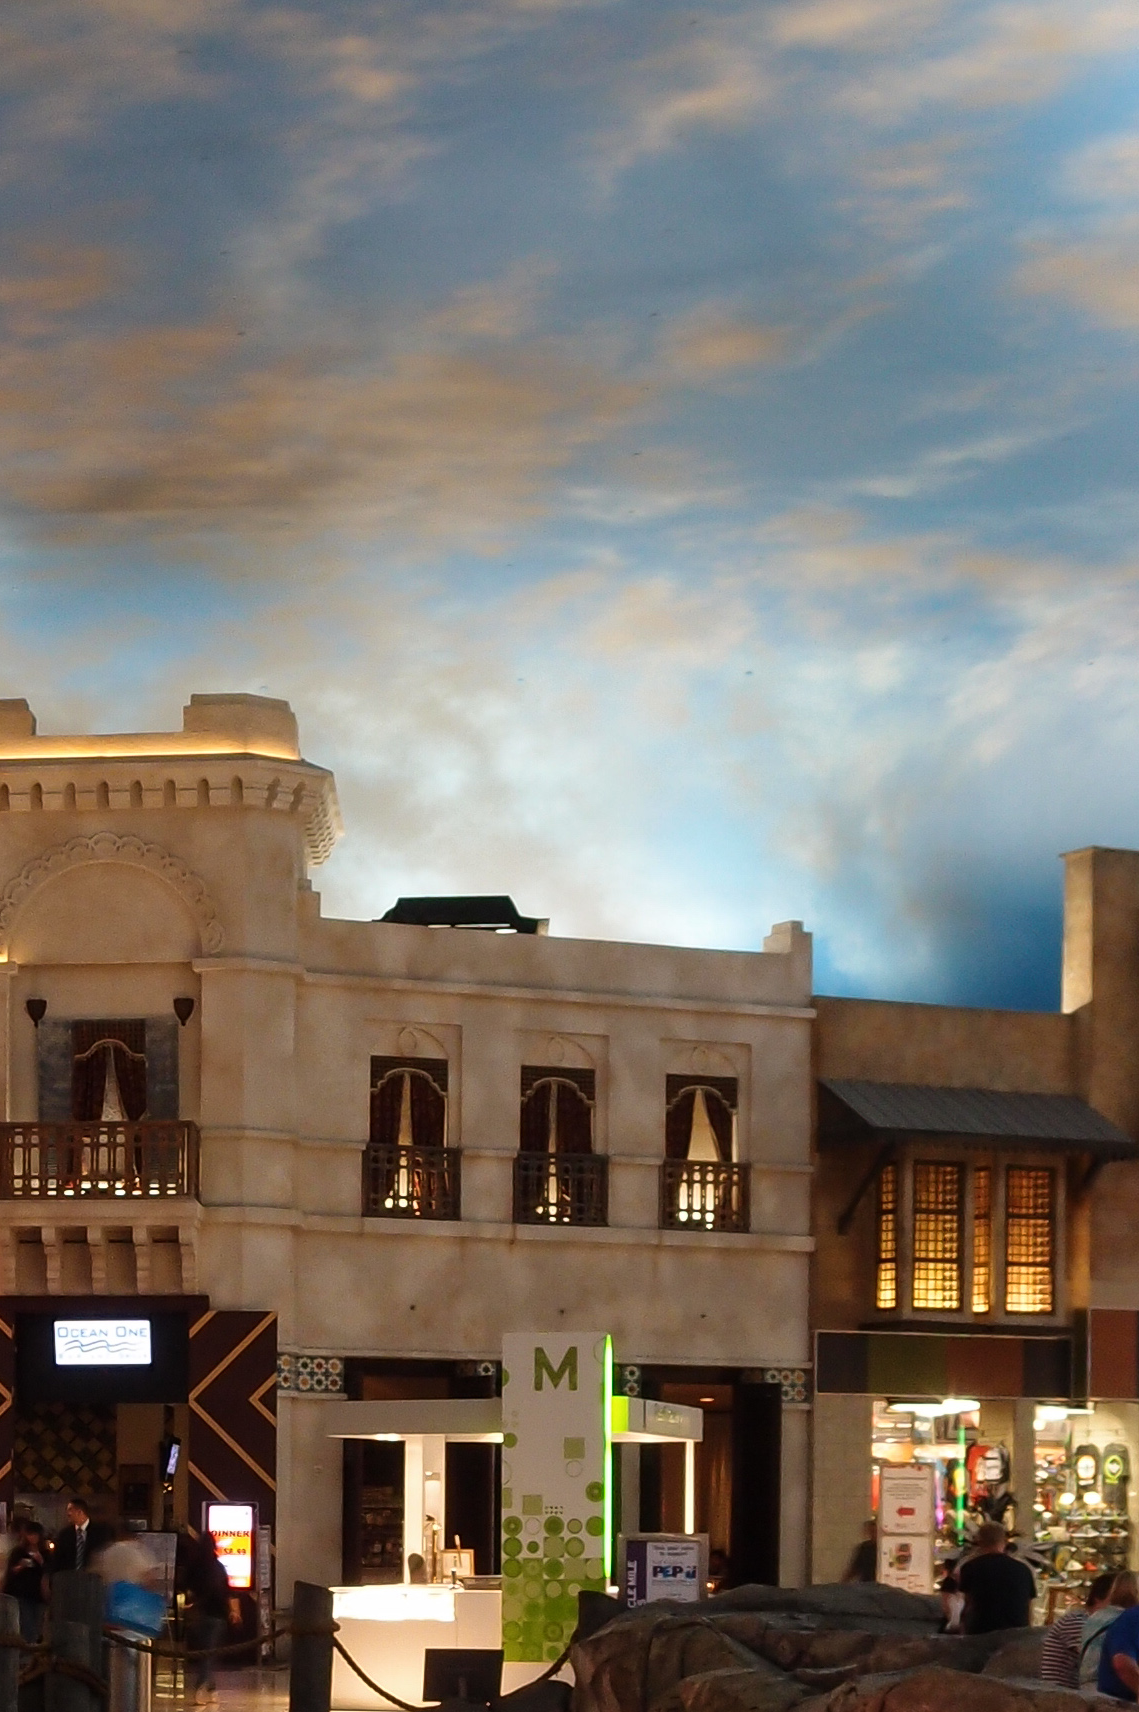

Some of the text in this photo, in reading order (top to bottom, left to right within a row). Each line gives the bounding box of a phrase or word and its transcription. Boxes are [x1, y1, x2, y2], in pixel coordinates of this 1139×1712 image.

[57, 1325, 148, 1338] OCEAN ONE
[534, 1346, 578, 1391] M
